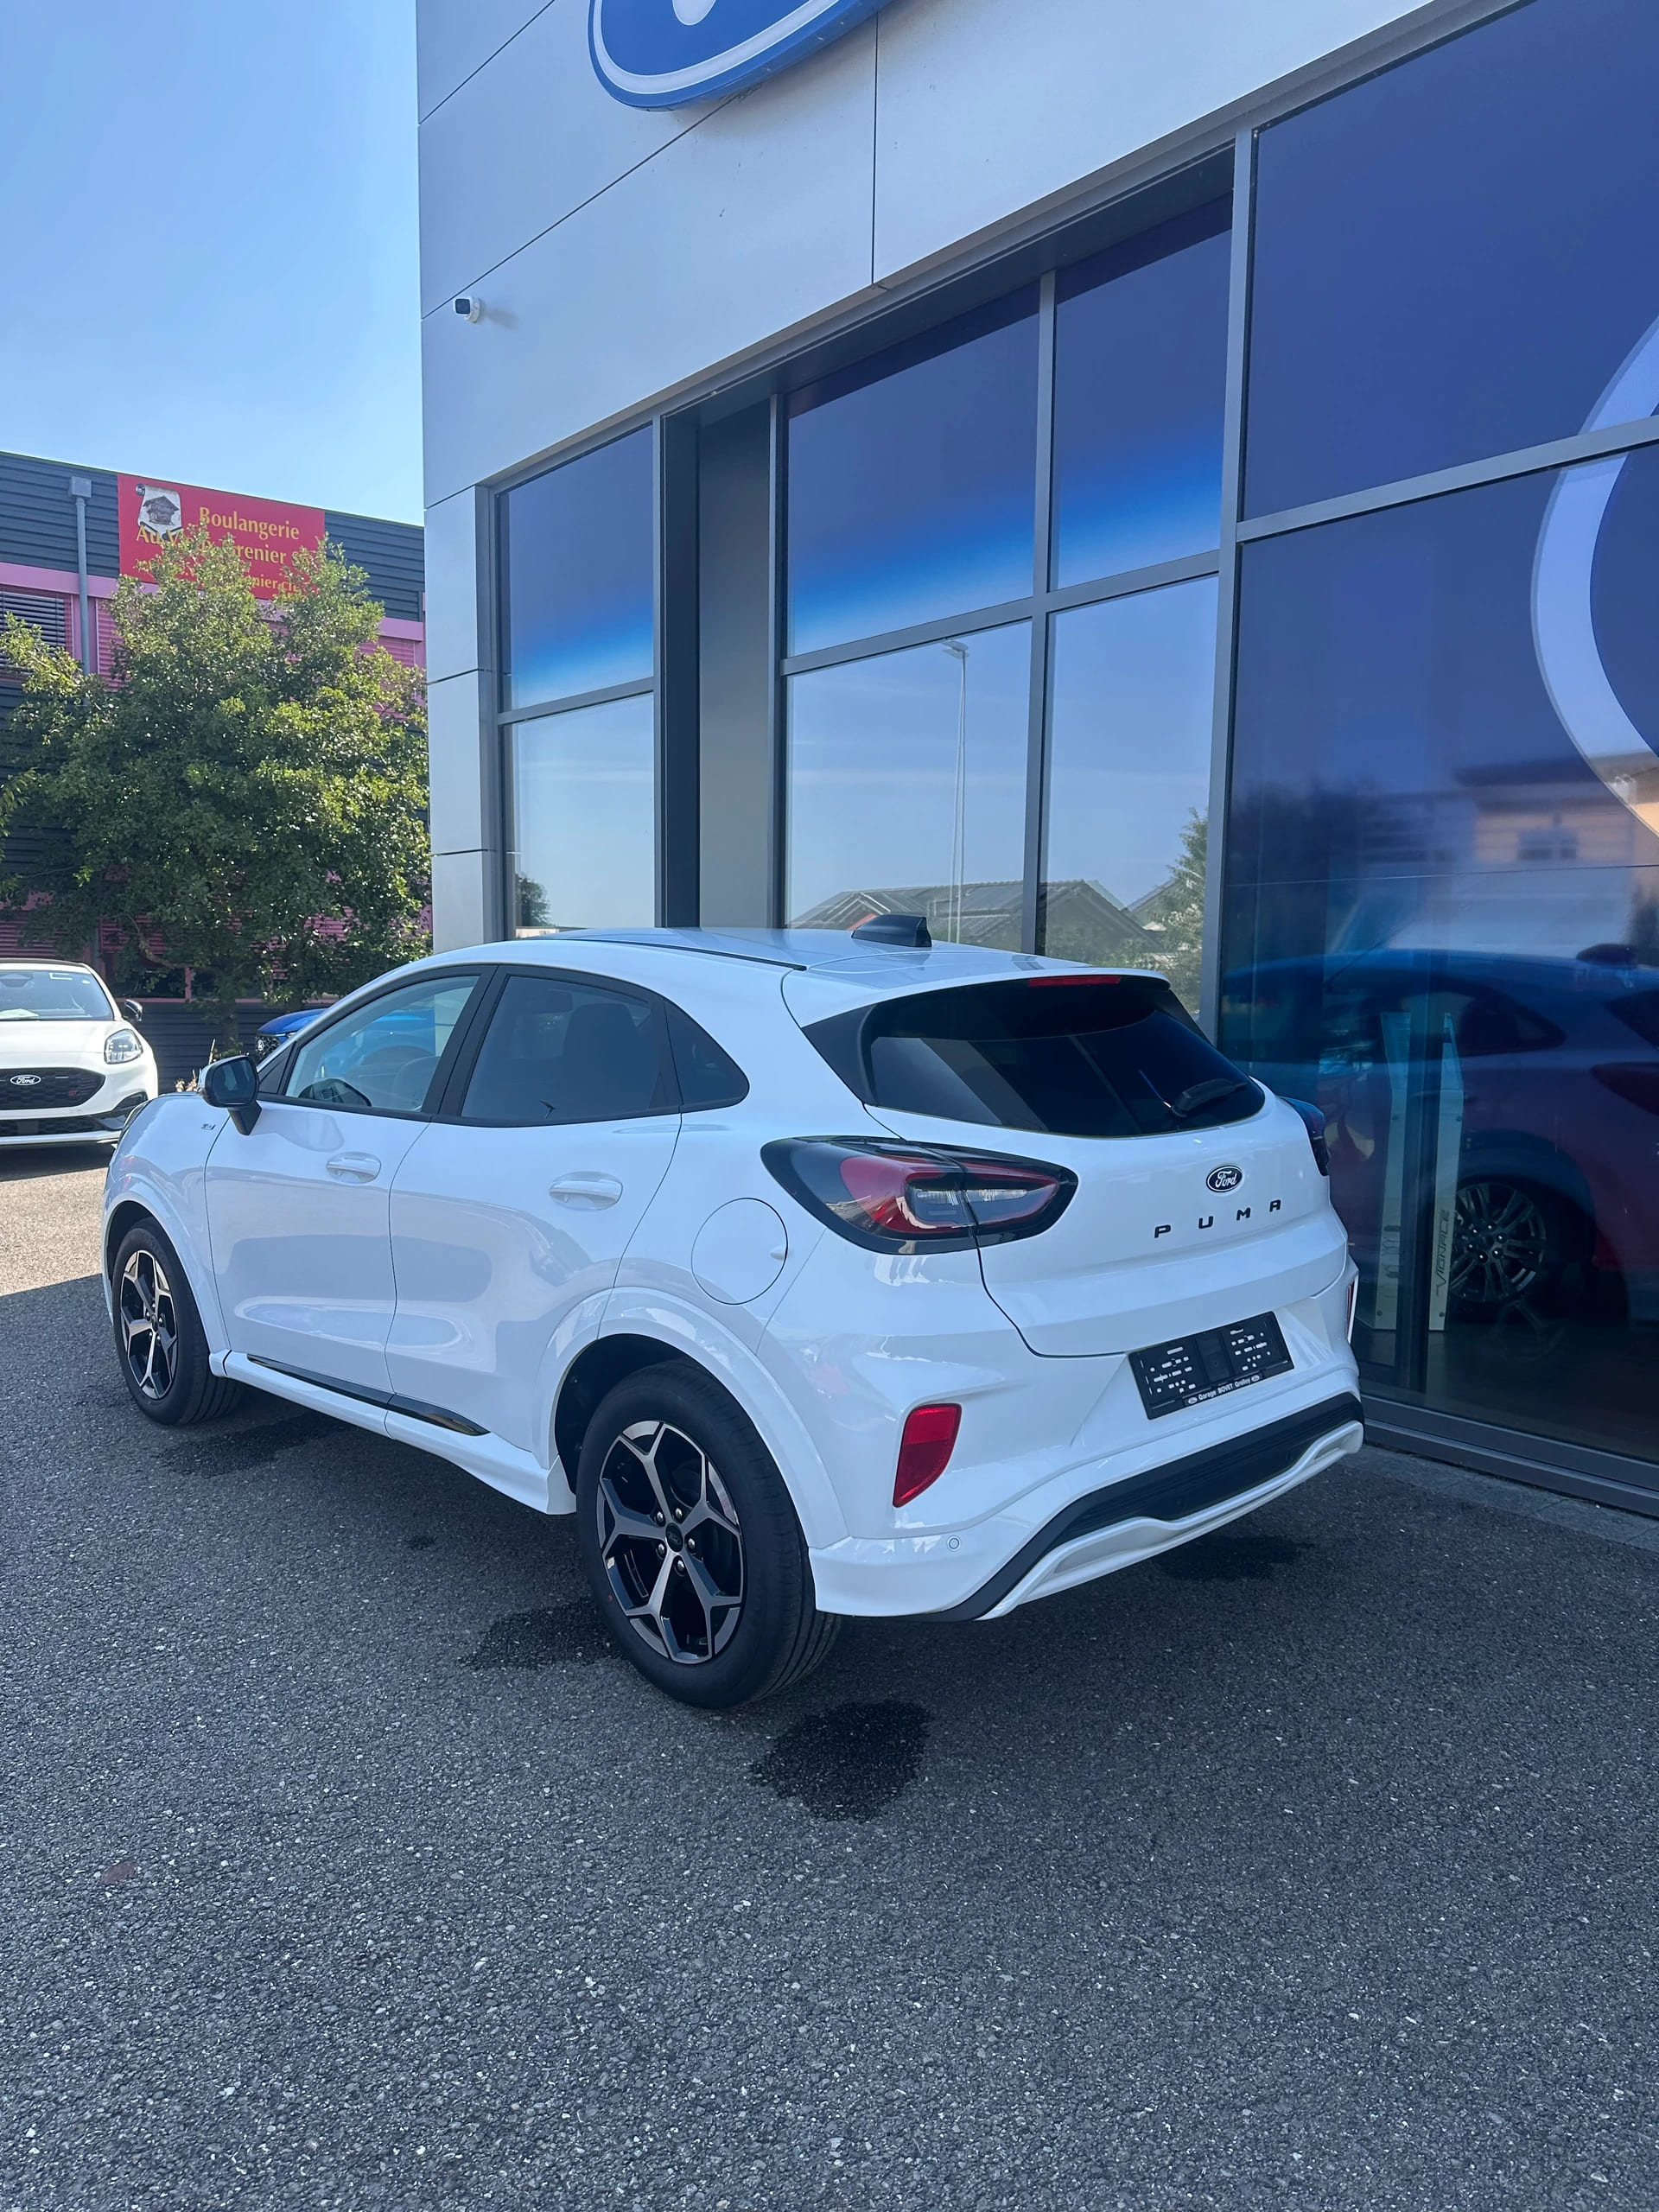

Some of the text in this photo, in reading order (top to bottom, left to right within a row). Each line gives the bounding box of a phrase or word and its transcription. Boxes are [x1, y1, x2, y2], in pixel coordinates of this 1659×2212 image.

[200, 506, 300, 540] Boulangerie
[136, 524, 162, 546] Au
[226, 541, 287, 564] renier
[16, 1076, 35, 1084] Ford
[1213, 1169, 1239, 1189] Ford
[1154, 1198, 1281, 1239] PUMA
[1198, 1390, 1217, 1401] Garage
[1217, 1383, 1234, 1394] BOVET
